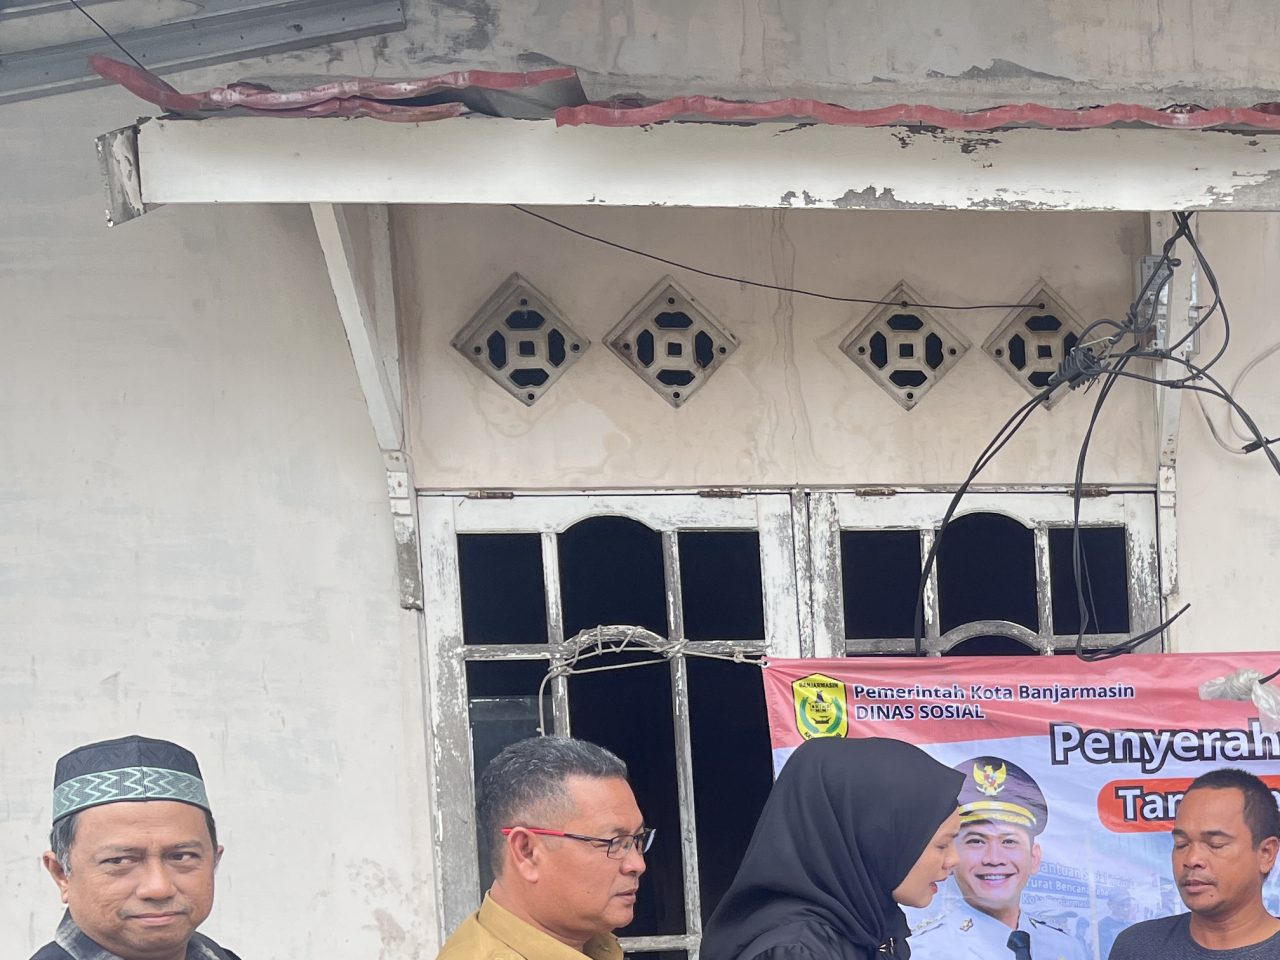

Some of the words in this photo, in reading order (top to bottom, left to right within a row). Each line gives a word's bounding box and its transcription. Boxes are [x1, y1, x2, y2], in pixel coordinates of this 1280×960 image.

[853, 684, 965, 700] Pemerintah
[971, 685, 1012, 700] Kota
[1019, 684, 1135, 704] Banjarmasin
[856, 704, 914, 720] DINAS
[919, 704, 985, 720] SOSIAL
